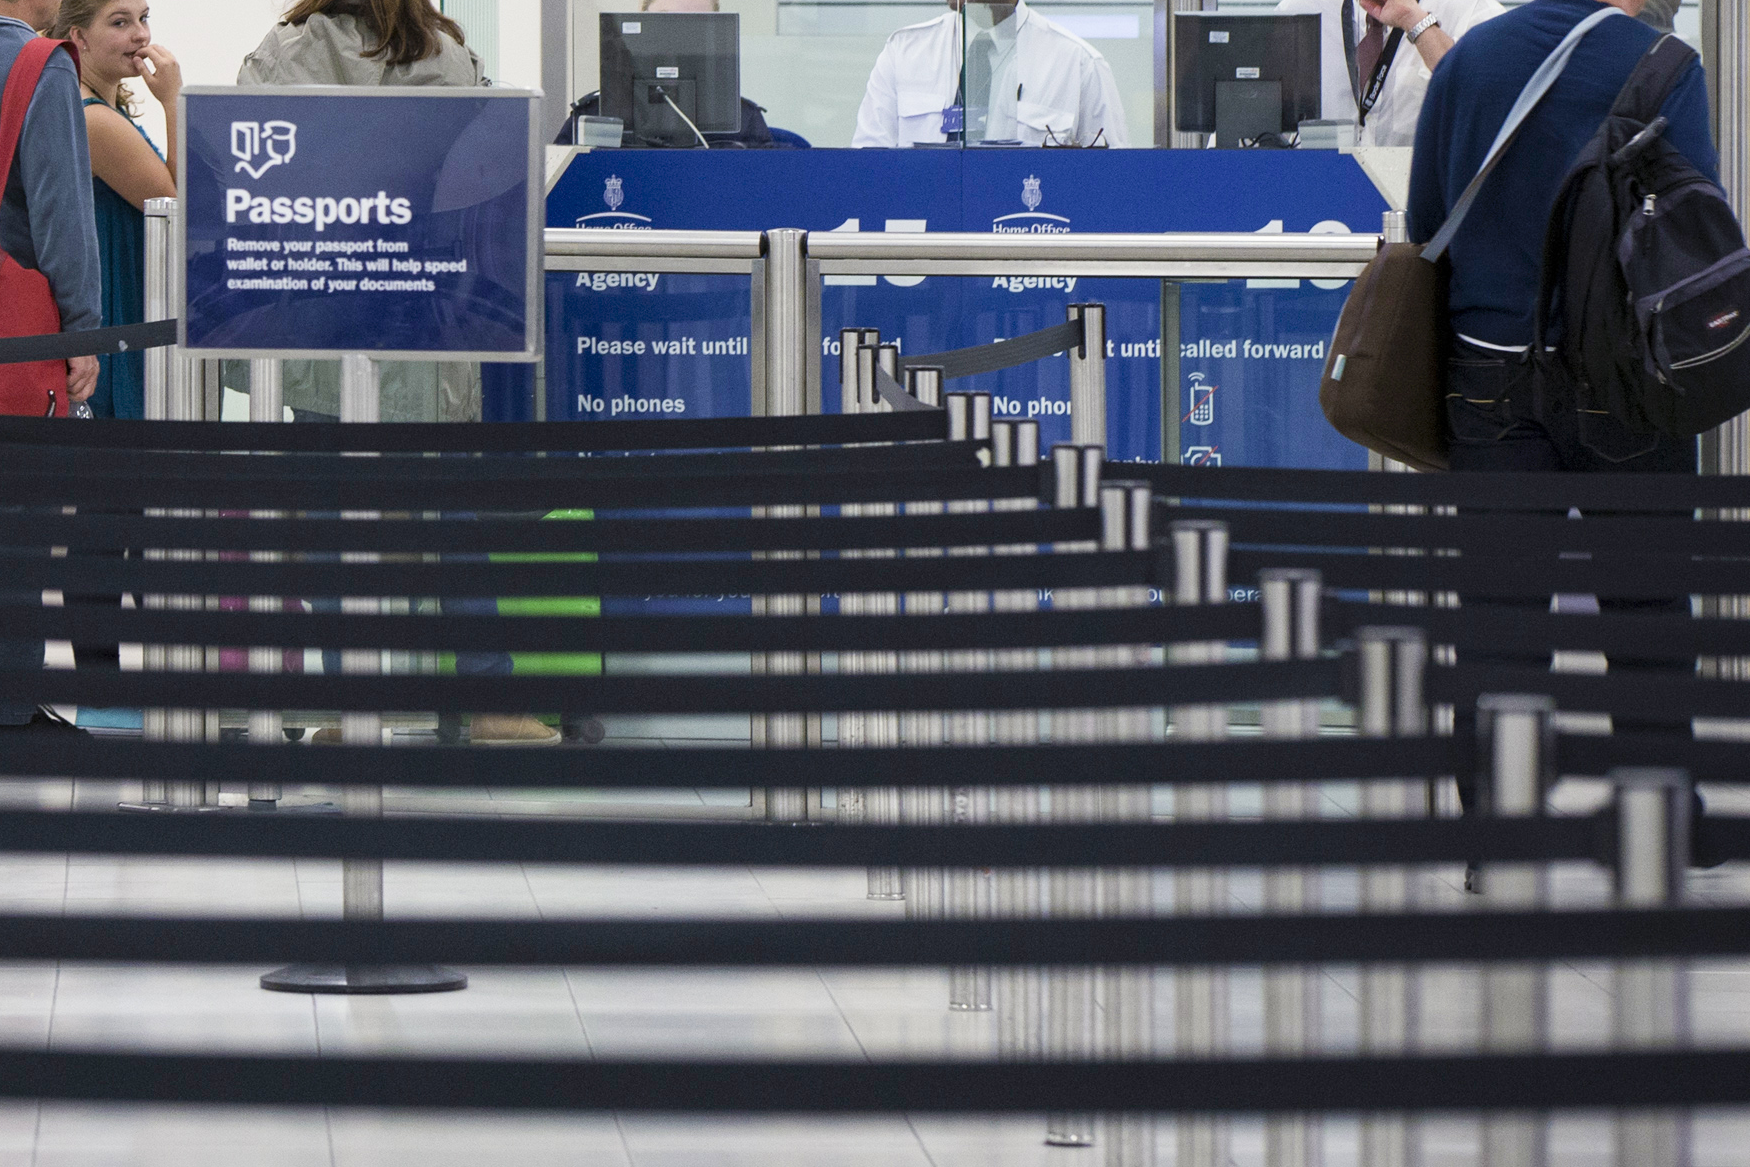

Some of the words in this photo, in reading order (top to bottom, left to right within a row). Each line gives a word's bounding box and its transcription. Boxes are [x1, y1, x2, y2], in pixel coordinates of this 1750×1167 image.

[226, 188, 412, 232] Passports
[226, 237, 281, 252] Remove
[283, 239, 313, 254] your
[315, 238, 374, 254] passport
[376, 238, 409, 253] from
[226, 257, 268, 271] wallet
[270, 260, 285, 271] or
[287, 257, 333, 271] holder.
[336, 257, 363, 271] This
[365, 258, 390, 272] will
[392, 258, 422, 275] help
[424, 259, 467, 275] speed
[226, 276, 308, 291] examination
[310, 276, 326, 290] of
[327, 279, 357, 293] your
[359, 277, 436, 293] documents
[576, 273, 660, 292] Agency
[577, 337, 646, 355] Please
[652, 337, 696, 355] wait
[701, 337, 748, 355] until
[1120, 339, 1161, 358] unti
[1243, 339, 1325, 359] forward
[577, 394, 605, 413] No
[611, 394, 686, 416] phones
[993, 396, 1021, 415] No
